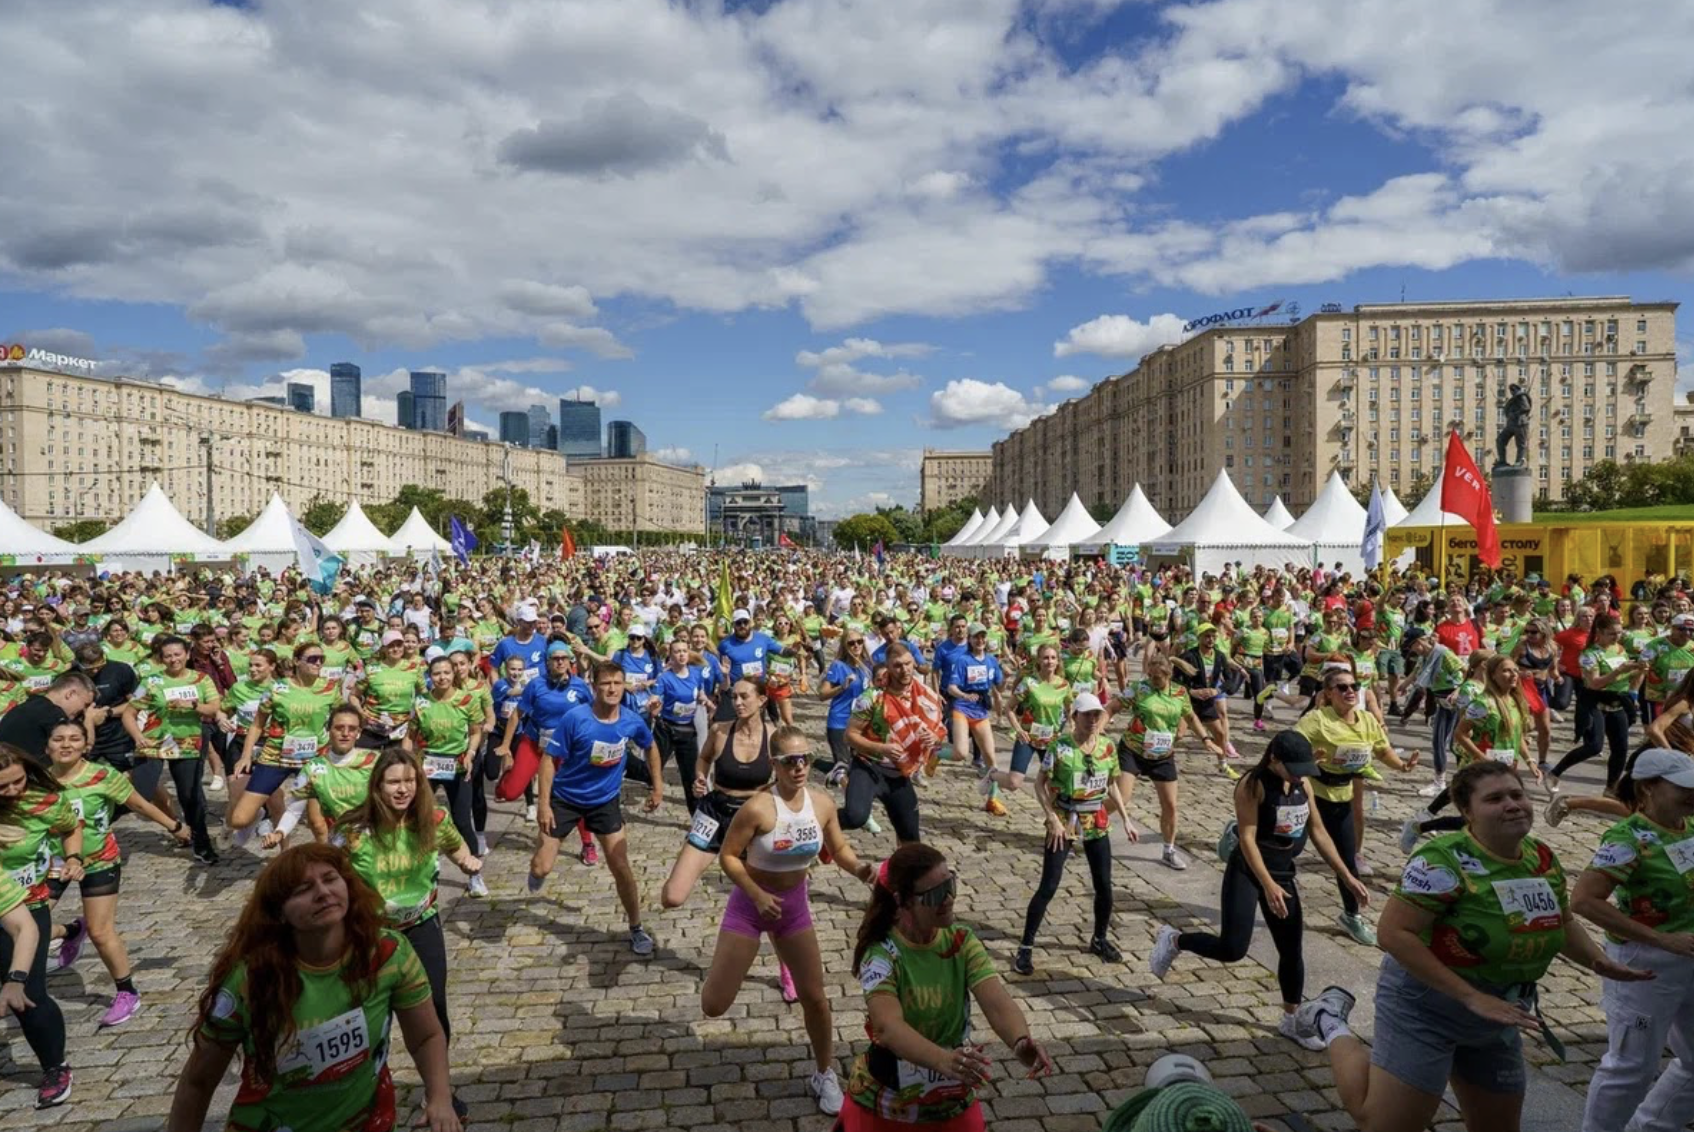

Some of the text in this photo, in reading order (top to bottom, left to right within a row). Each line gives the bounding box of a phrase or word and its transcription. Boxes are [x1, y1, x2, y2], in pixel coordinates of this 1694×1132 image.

[1182, 307, 1255, 333] АЭРОФЛОТ
[29, 348, 97, 369] Маркет
[1449, 537, 1541, 551] бего столу
[795, 826, 818, 842] 3585
[377, 853, 411, 873] RUN
[1523, 892, 1556, 912] 0456
[316, 1026, 364, 1063] 1595
